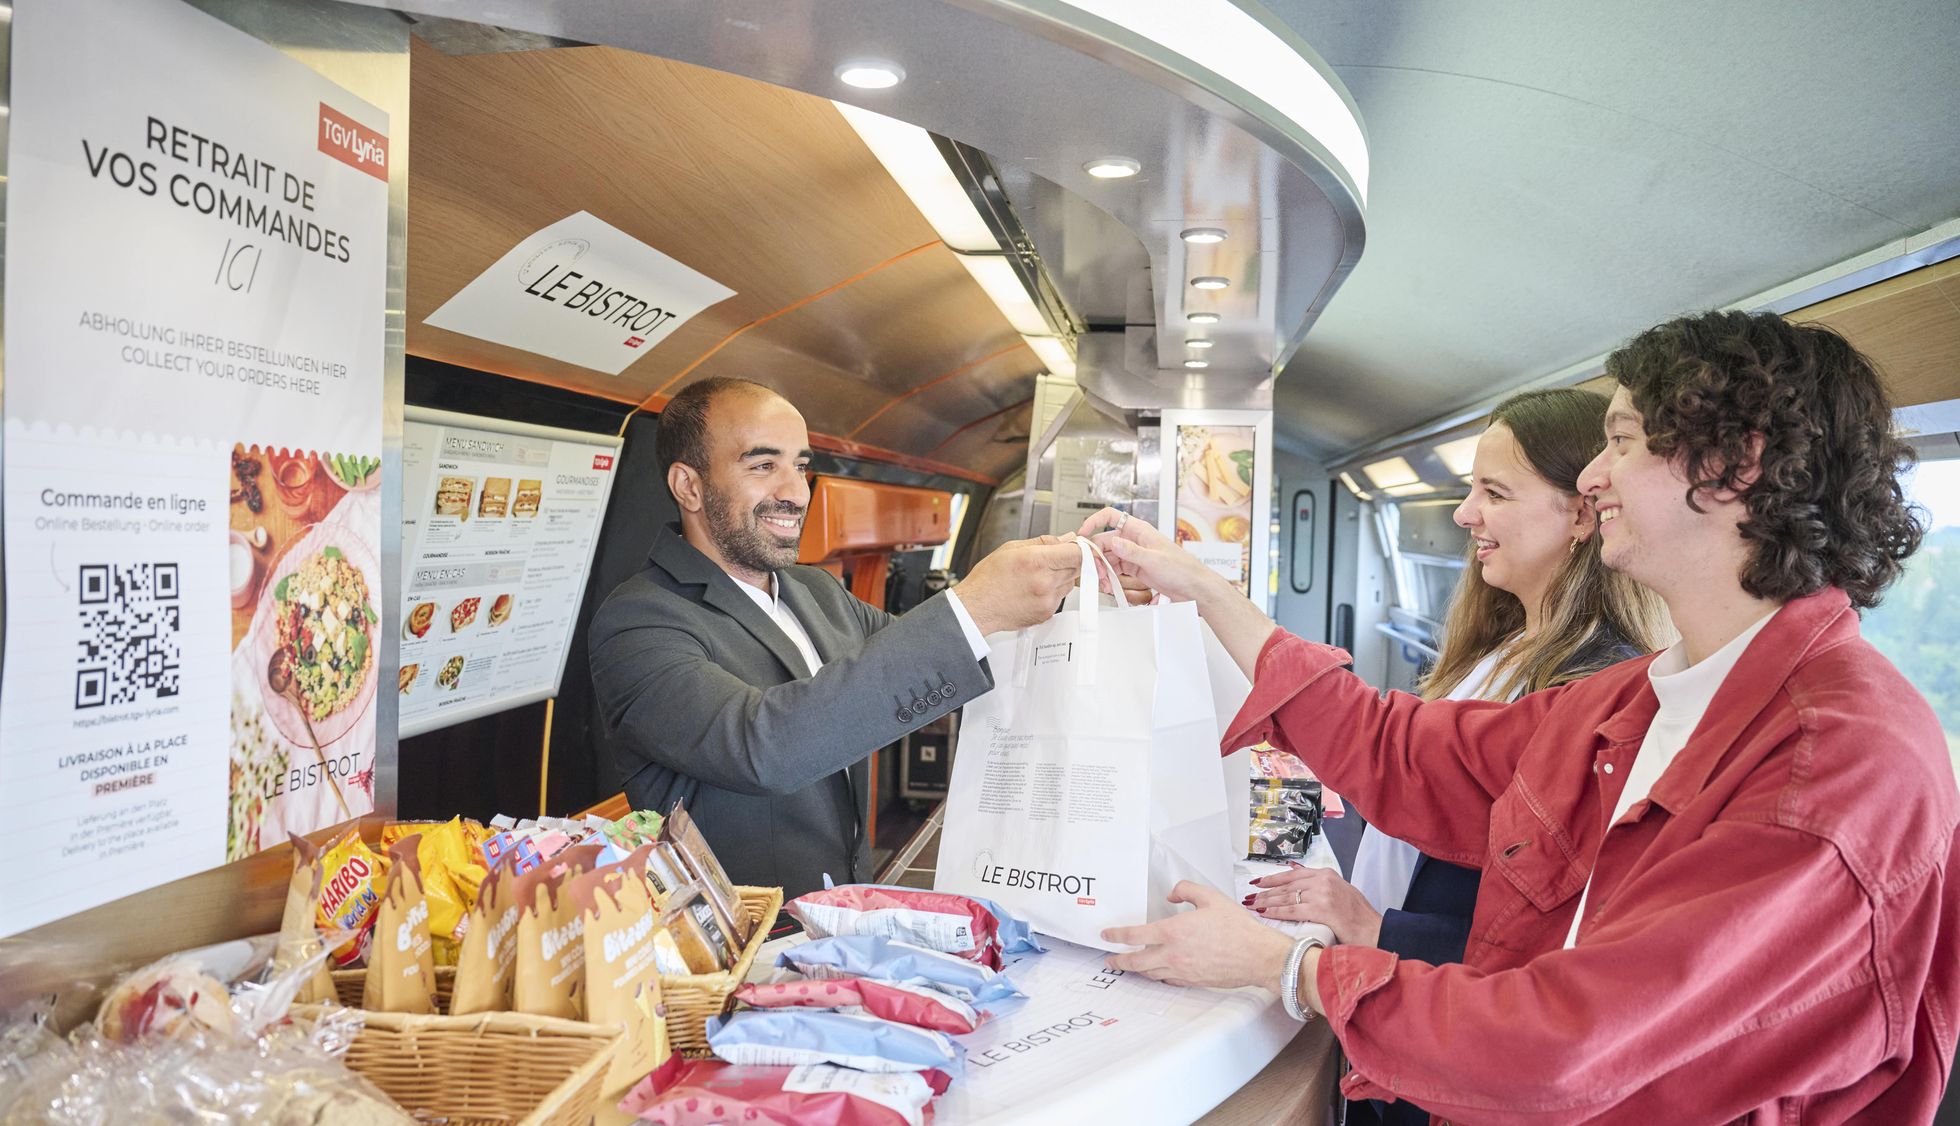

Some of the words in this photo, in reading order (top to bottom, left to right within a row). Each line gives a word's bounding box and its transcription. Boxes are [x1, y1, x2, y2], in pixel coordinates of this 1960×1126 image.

[147, 117, 275, 194] RETRAIT
[283, 172, 315, 212] DE
[82, 140, 157, 197] VOS
[170, 174, 351, 264] COMMANDES
[215, 238, 262, 294] ICI
[525, 264, 584, 302] LE
[563, 280, 677, 336] BISTROT
[79, 310, 175, 345] ABHOLUNG
[180, 331, 224, 355] IHRER
[228, 341, 319, 374] BESTELLUNGEN
[322, 361, 347, 379] HIER
[121, 345, 192, 373] COLLECT
[196, 357, 234, 380] YOUR
[238, 366, 287, 391] ORDERS
[290, 376, 320, 395] HERE
[35, 516, 78, 532] Online
[81, 517, 141, 534] Bestellung
[148, 519, 181, 532] Online
[184, 519, 210, 533] order
[41, 488, 143, 511] Commande
[148, 496, 166, 511] en
[170, 490, 206, 516] ligne
[58, 747, 123, 769] LIVRAISON
[126, 743, 135, 756] À
[137, 741, 151, 754] LA
[154, 734, 188, 750] PLACE
[80, 758, 151, 782] DISPONIBLE
[154, 755, 168, 766] EN
[263, 773, 285, 800] LE
[290, 752, 360, 792] BISTROT
[95, 773, 154, 797] PREMIÈRE
[320, 856, 370, 920] HARIBO
[981, 864, 1005, 885] LE
[1007, 868, 1096, 896] BISTROT
[968, 1050, 1010, 1068] LE
[1004, 1011, 1105, 1053] BISTROT
